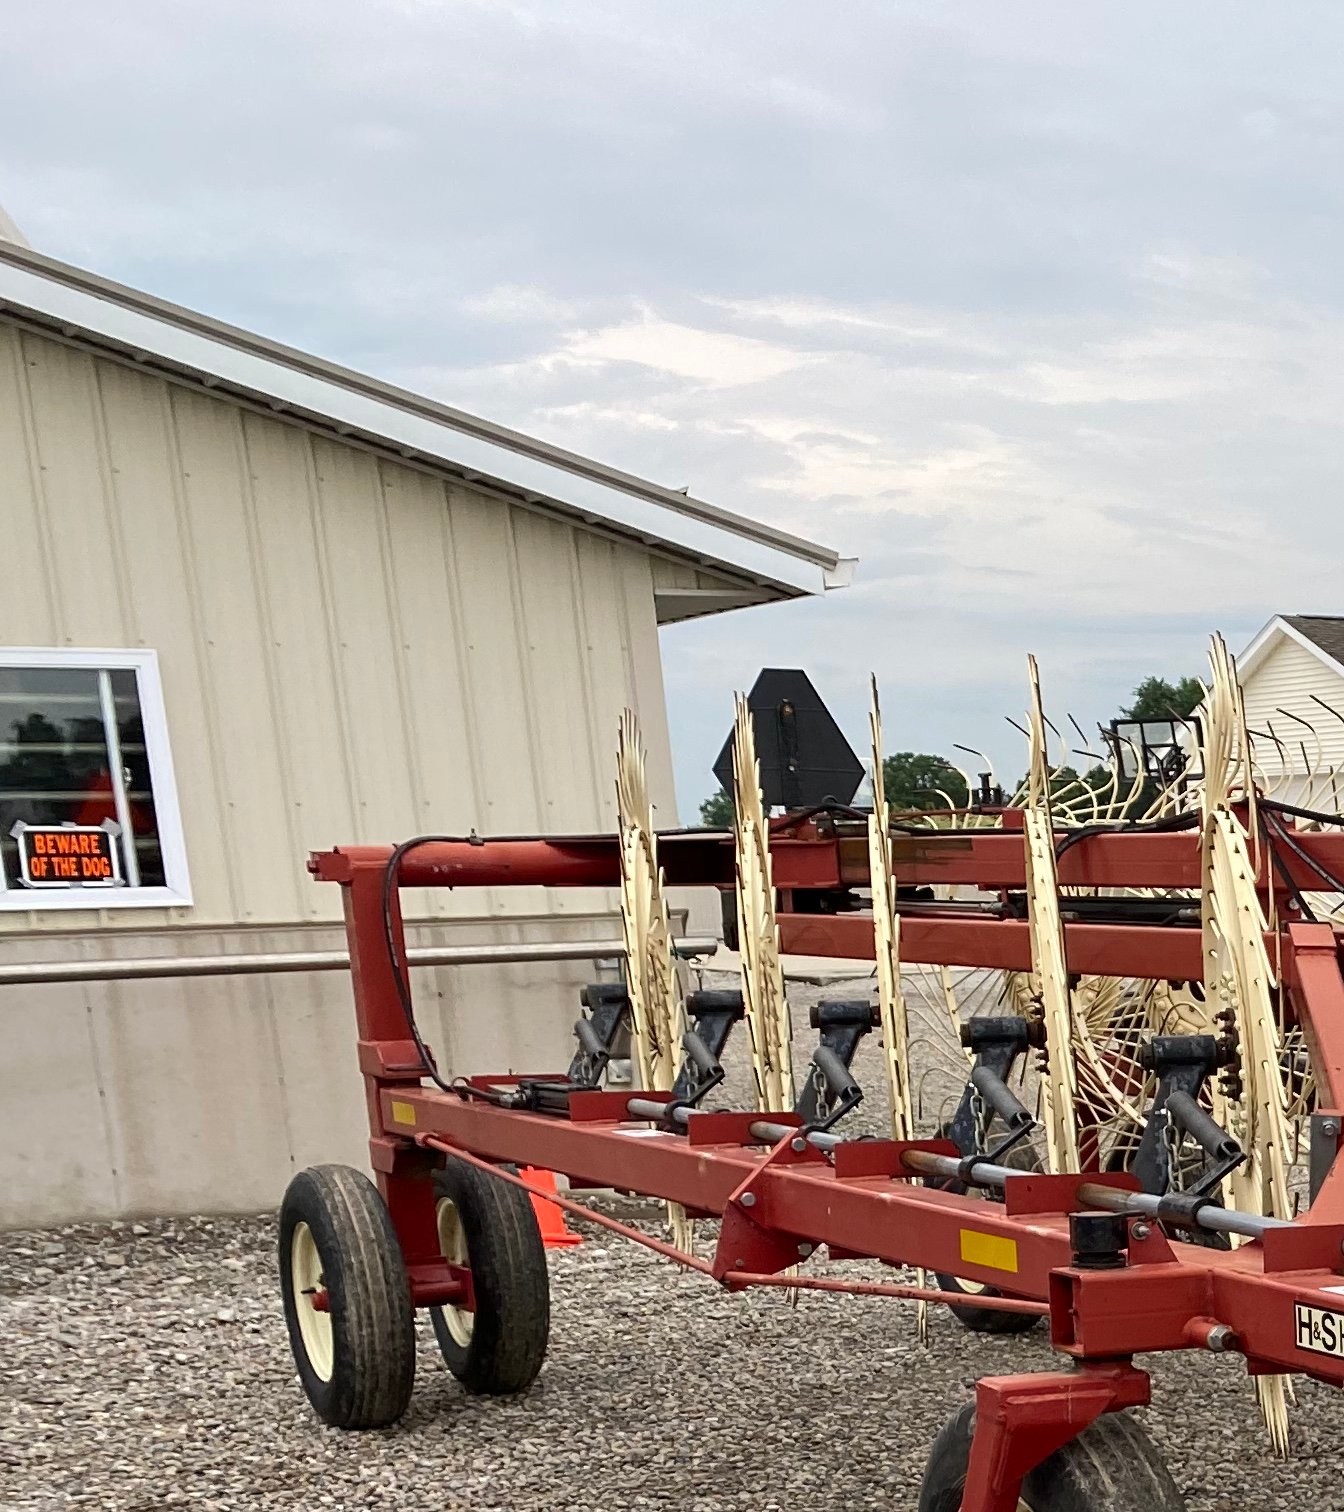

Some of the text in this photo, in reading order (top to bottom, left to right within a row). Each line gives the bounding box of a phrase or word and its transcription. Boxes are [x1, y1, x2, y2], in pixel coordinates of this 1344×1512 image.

[34, 834, 100, 853] BEWARE
[30, 857, 110, 877] OF THE DOG
[1297, 1307, 1337, 1351] H&S
